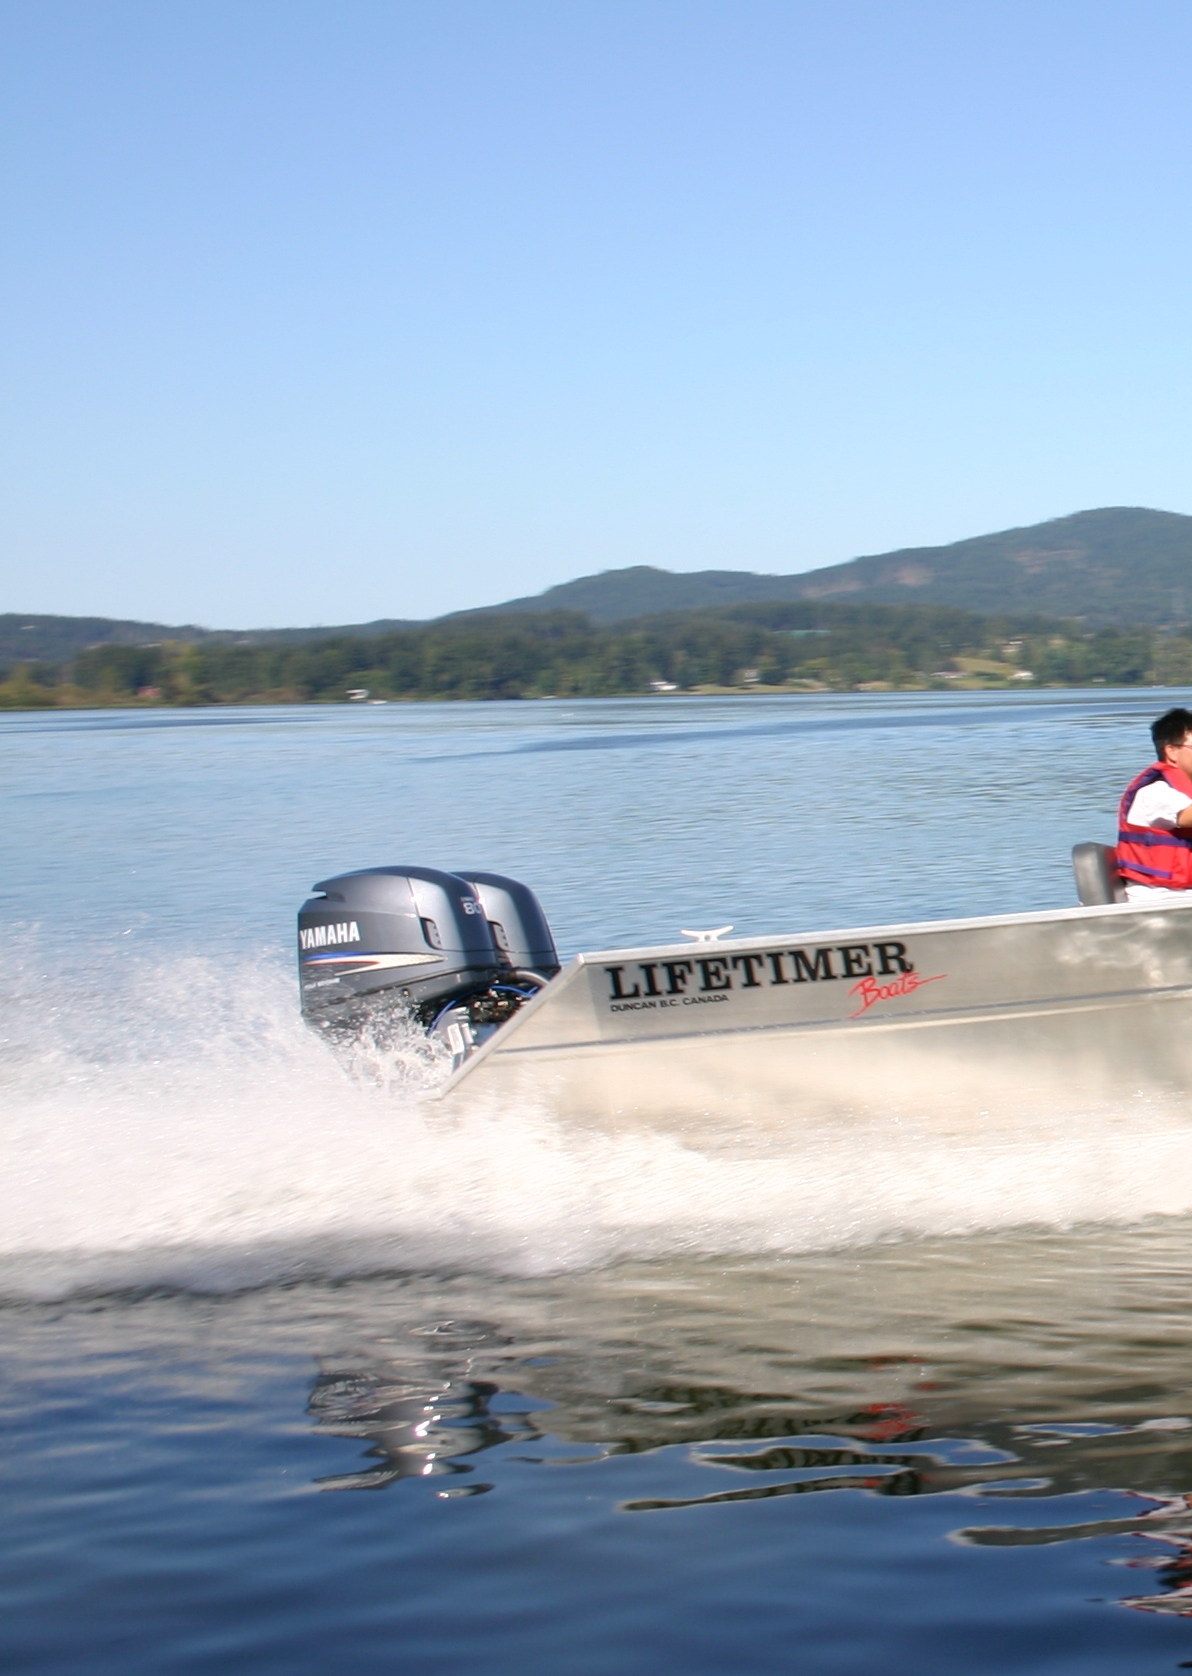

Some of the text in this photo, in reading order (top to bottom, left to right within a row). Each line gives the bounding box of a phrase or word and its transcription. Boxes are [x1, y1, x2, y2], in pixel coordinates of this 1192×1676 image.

[300, 921, 361, 950] YAMAHA
[606, 942, 915, 1000] LIFETIMER
[610, 1001, 657, 1012] DUNCAN
[682, 994, 730, 1006] CANADA
[848, 972, 948, 1020] Boats
